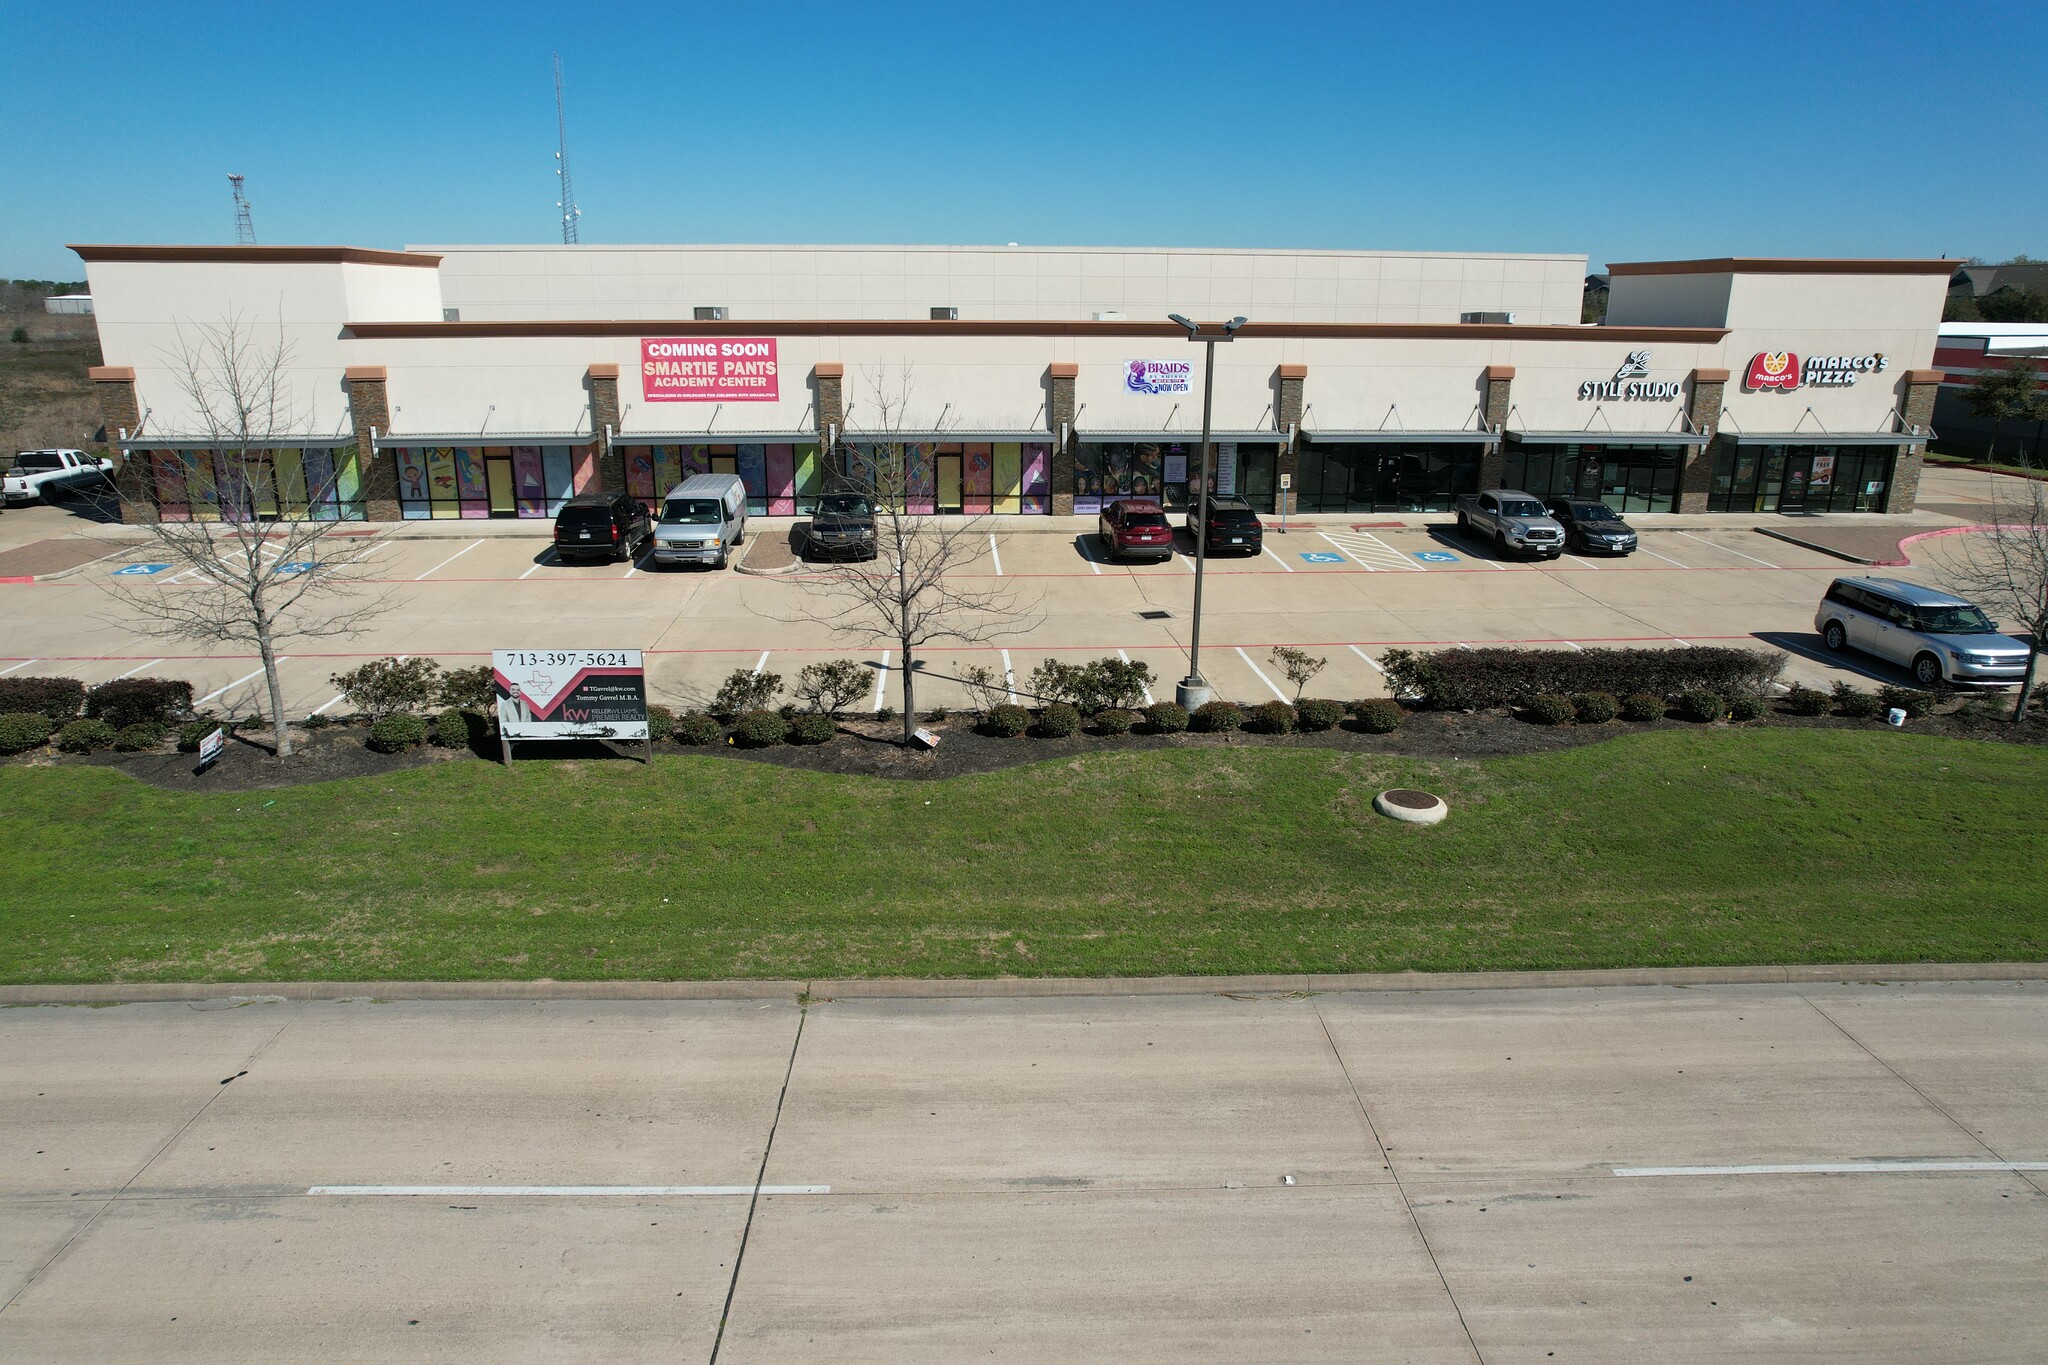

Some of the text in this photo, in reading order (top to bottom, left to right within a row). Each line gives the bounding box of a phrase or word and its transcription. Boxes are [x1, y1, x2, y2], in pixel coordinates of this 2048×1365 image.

[648, 343, 769, 357] COMING SOON
[1807, 353, 1889, 369] MARCO'S
[644, 361, 776, 376] SMARTIE PANTS
[1147, 363, 1190, 374] BRAIDS
[654, 377, 767, 387] ACADEMY CENTER
[1755, 373, 1792, 382] MARCO'S
[1805, 370, 1856, 383] PIZZA
[1158, 383, 1188, 391] NOW OPEN
[1582, 381, 1681, 397] STYLE STUDIO
[507, 653, 627, 666] 713-397-5624
[562, 704, 590, 721] kw
